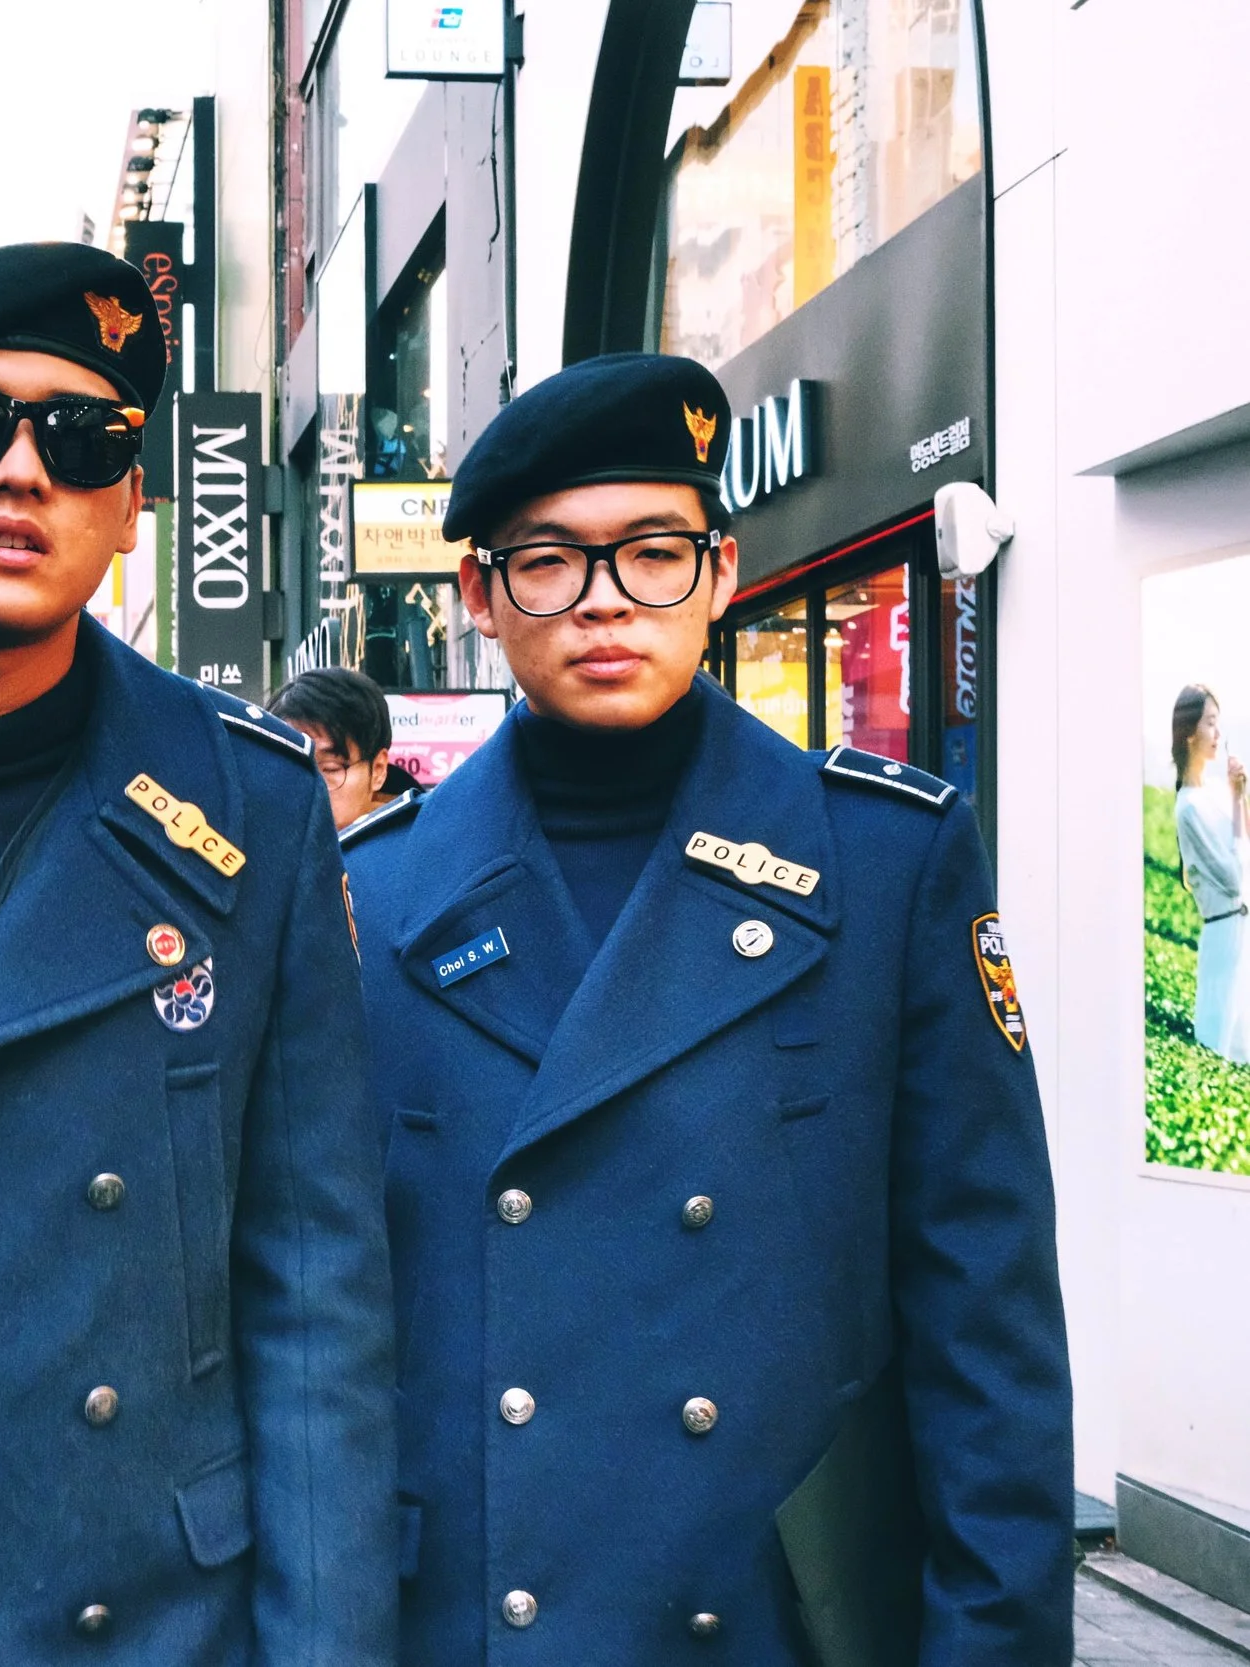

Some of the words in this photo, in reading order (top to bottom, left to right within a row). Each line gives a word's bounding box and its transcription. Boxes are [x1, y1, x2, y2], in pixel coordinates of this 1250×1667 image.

[400, 49, 492, 63] LOUNGE
[720, 378, 802, 513] UM
[192, 423, 248, 609] MIXXO
[200, 663, 242, 685] 미쏘
[132, 780, 237, 869] POLICE
[691, 838, 812, 888] POLICE
